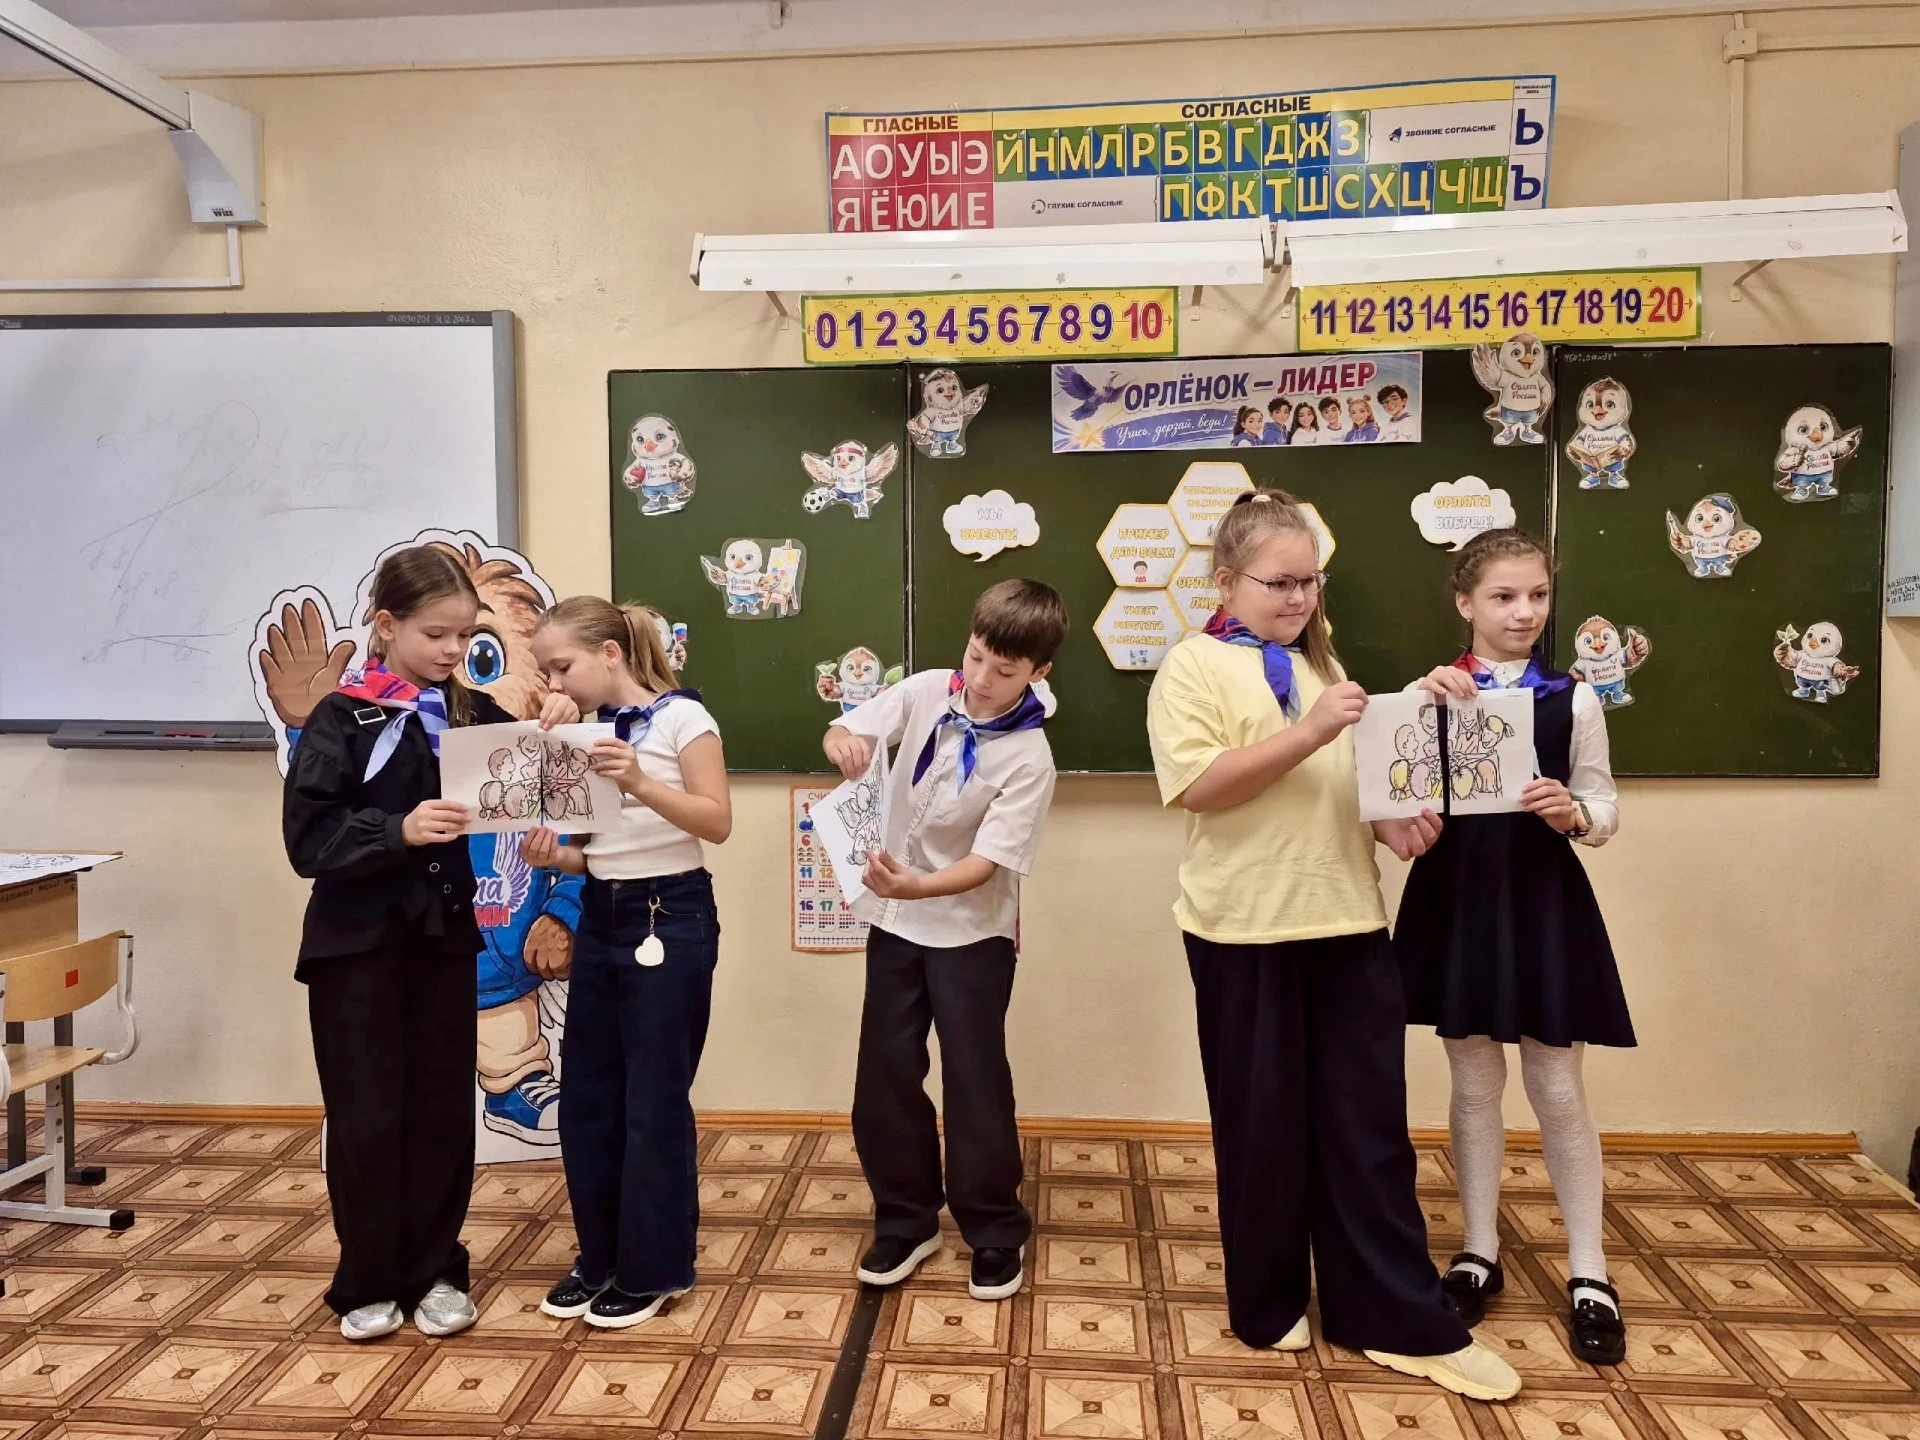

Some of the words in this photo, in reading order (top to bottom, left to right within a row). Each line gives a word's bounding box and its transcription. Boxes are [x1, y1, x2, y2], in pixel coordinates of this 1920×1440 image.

[1181, 96, 1311, 119] СОГЛАСНЫЕ
[863, 115, 958, 133] ГЛАСНЫЕ
[1405, 128, 1442, 137] ЗВОНКИЕ
[1444, 124, 1497, 134] СОГЛАСНЫЕ
[1515, 108, 1544, 145] Ь
[1510, 164, 1541, 201] Ъ
[1077, 200, 1123, 208] СОГЛАСНЫЕ
[1310, 299, 1336, 334] 11
[1345, 297, 1376, 334] 12
[1383, 296, 1414, 332] 13
[1420, 294, 1452, 331] 14
[1458, 293, 1490, 329] 15
[1497, 290, 1528, 327] 16
[1536, 289, 1567, 326] 17
[1573, 288, 1604, 324] 18
[1610, 287, 1642, 324] 19
[1648, 286, 1684, 323] 20
[815, 311, 838, 349] 0
[846, 310, 863, 348] 1
[875, 309, 898, 348] 2
[905, 308, 928, 347] 3
[935, 306, 959, 345] 4
[967, 305, 990, 345] 5
[997, 304, 1020, 344] 6
[1028, 304, 1051, 343] 7
[1059, 303, 1081, 343] 8
[1090, 302, 1113, 342] 9
[1122, 301, 1163, 340] 10
[1125, 372, 1250, 411] ОРЛЁНОК
[1277, 362, 1376, 395] ЛИДЕР
[1511, 381, 1537, 391] Орлята
[1511, 391, 1537, 399] России
[1117, 426, 1151, 445] Учись,
[1152, 419, 1195, 442] дерзай,
[1198, 413, 1228, 433] веди!
[1433, 494, 1491, 509] ОРЛЯТА
[977, 507, 1004, 521] МЫ
[1118, 528, 1169, 540] ПРИМЕР
[1110, 546, 1137, 559] ДЛЯ
[1139, 546, 1176, 559] ВСЕХ!
[1123, 605, 1158, 615] УМЕЕТ
[1113, 620, 1165, 631] РАБОТАТЬ
[1116, 634, 1167, 647] КОМАНДЕ
[801, 834, 811, 846] 6
[799, 867, 812, 878] 11
[819, 867, 833, 878] 12
[799, 900, 813, 911] 16
[819, 900, 833, 911] 17
